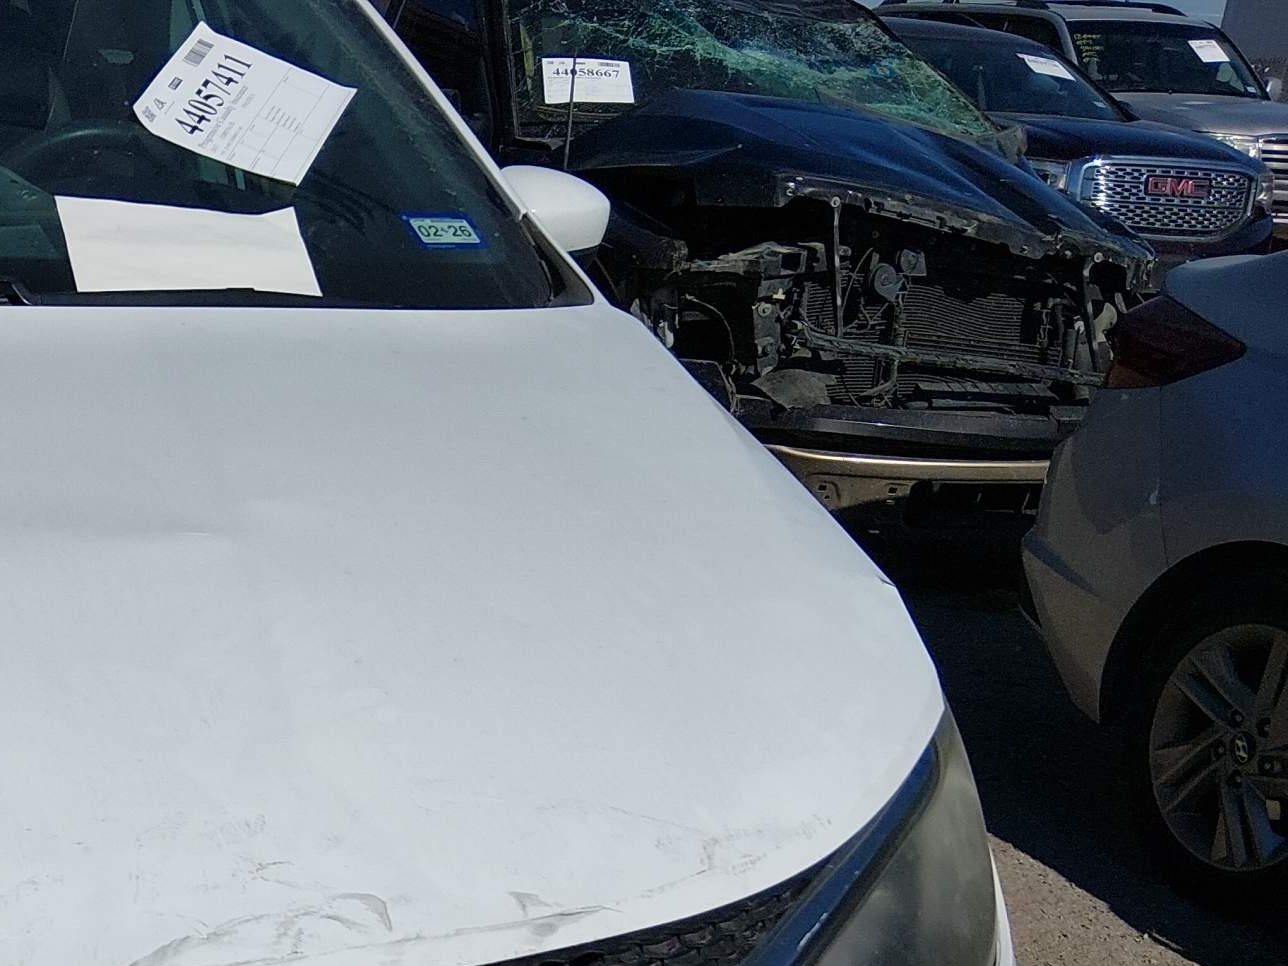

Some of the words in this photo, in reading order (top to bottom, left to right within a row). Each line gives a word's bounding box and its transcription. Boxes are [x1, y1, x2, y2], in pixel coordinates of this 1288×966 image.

[552, 67, 620, 78] 4458667
[175, 54, 253, 134] 44057411
[1148, 176, 1209, 197] GMC
